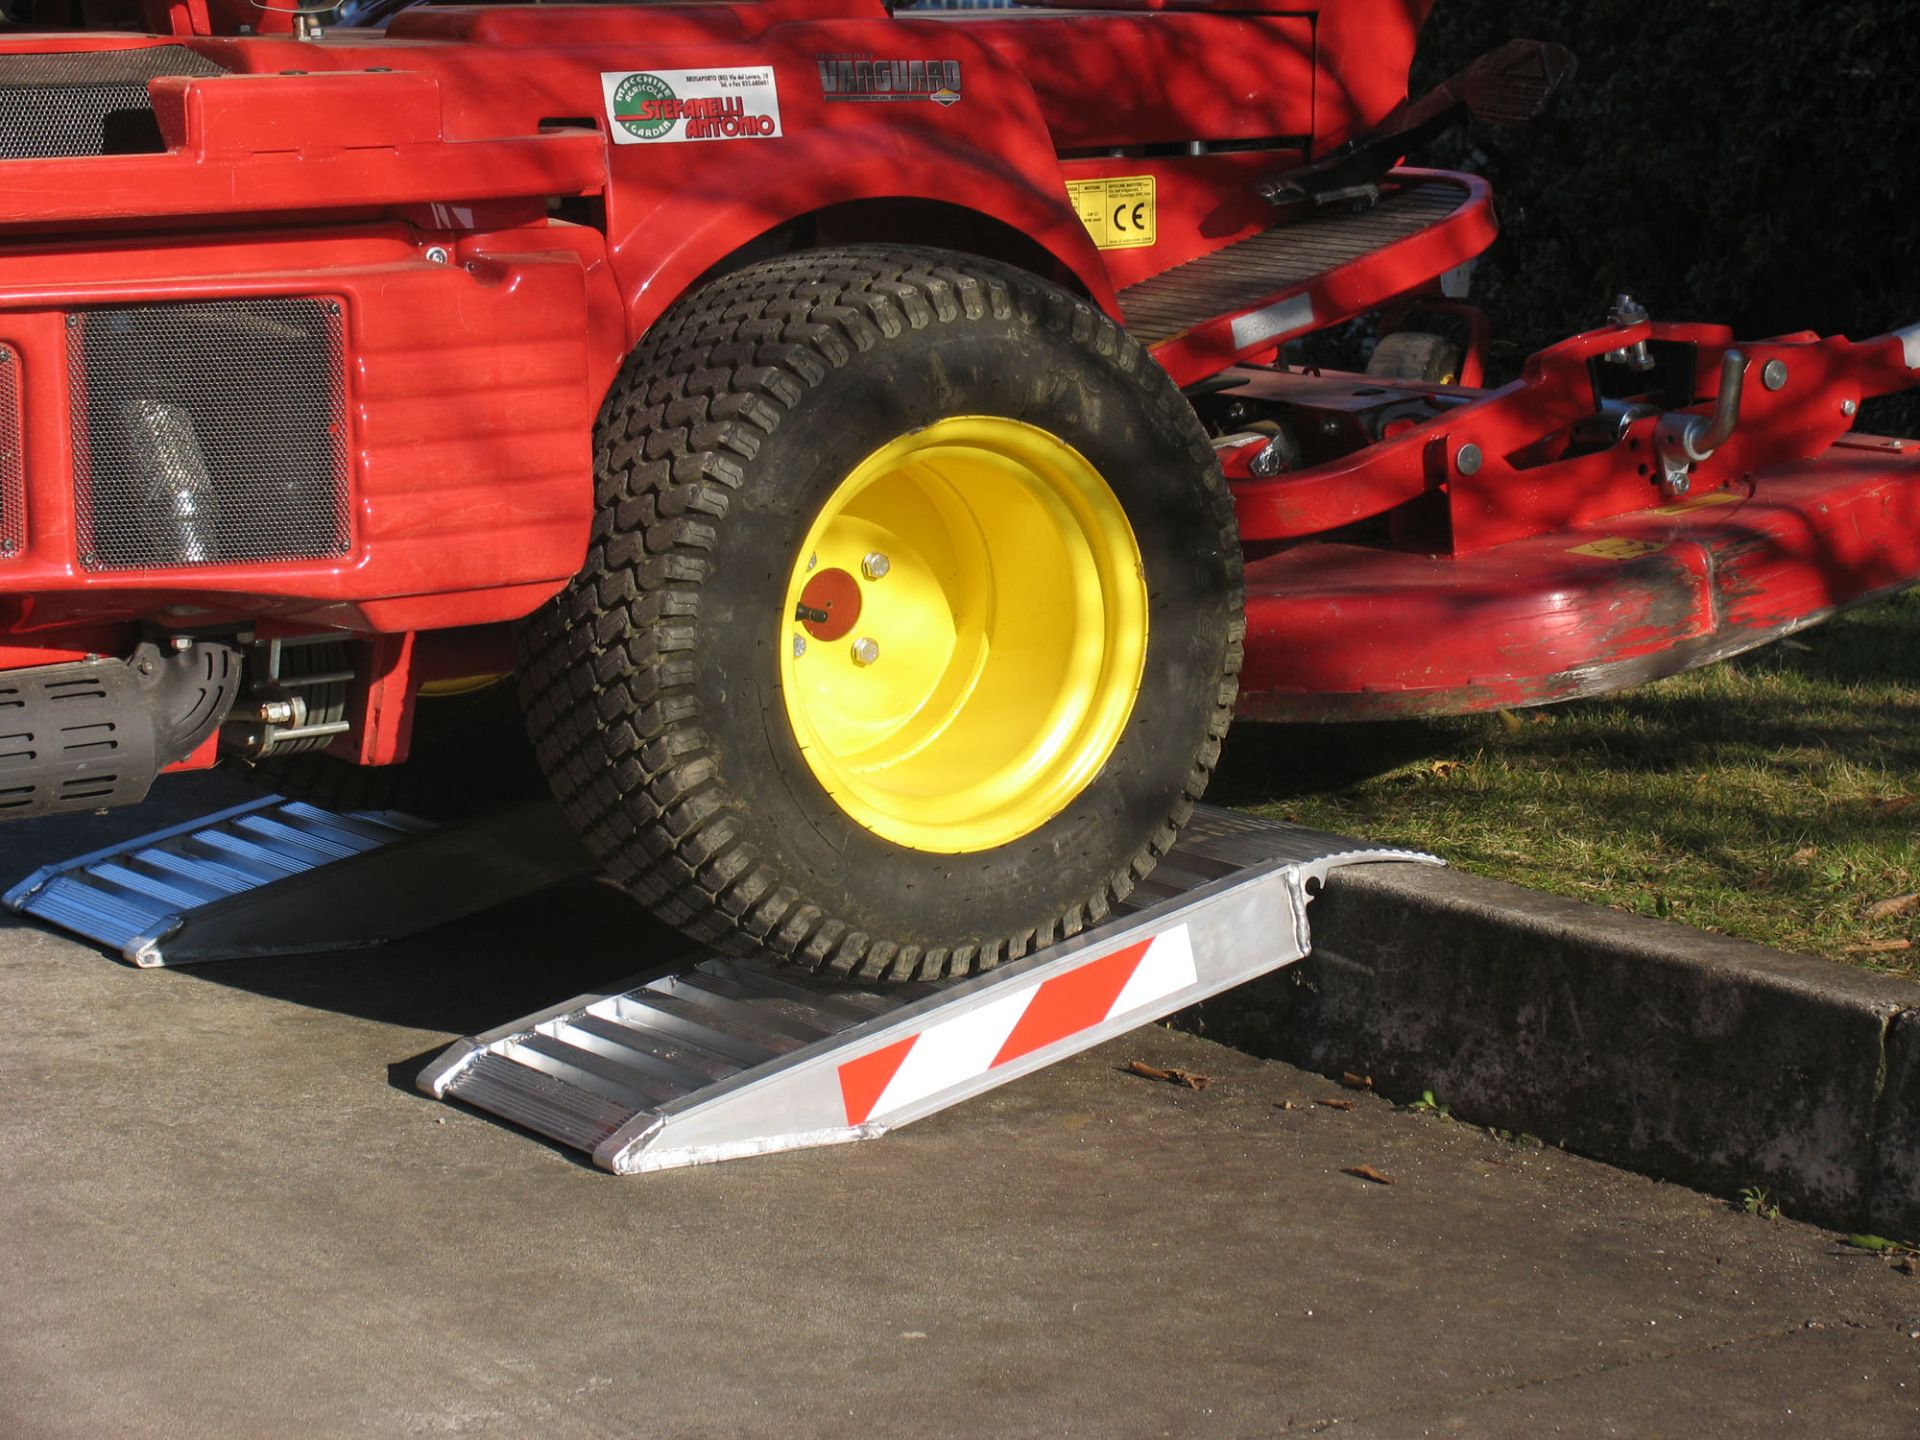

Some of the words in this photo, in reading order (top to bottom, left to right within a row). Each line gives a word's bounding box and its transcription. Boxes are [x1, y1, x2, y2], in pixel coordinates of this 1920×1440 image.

[616, 76, 672, 101] MACCHINE
[817, 60, 961, 92] VANGUARD
[625, 84, 664, 102] AGRICOLE
[615, 96, 744, 122] STEFANELLI
[630, 120, 671, 137] GARDEN
[686, 115, 775, 138] ANTONIO
[1114, 202, 1145, 232] CE
